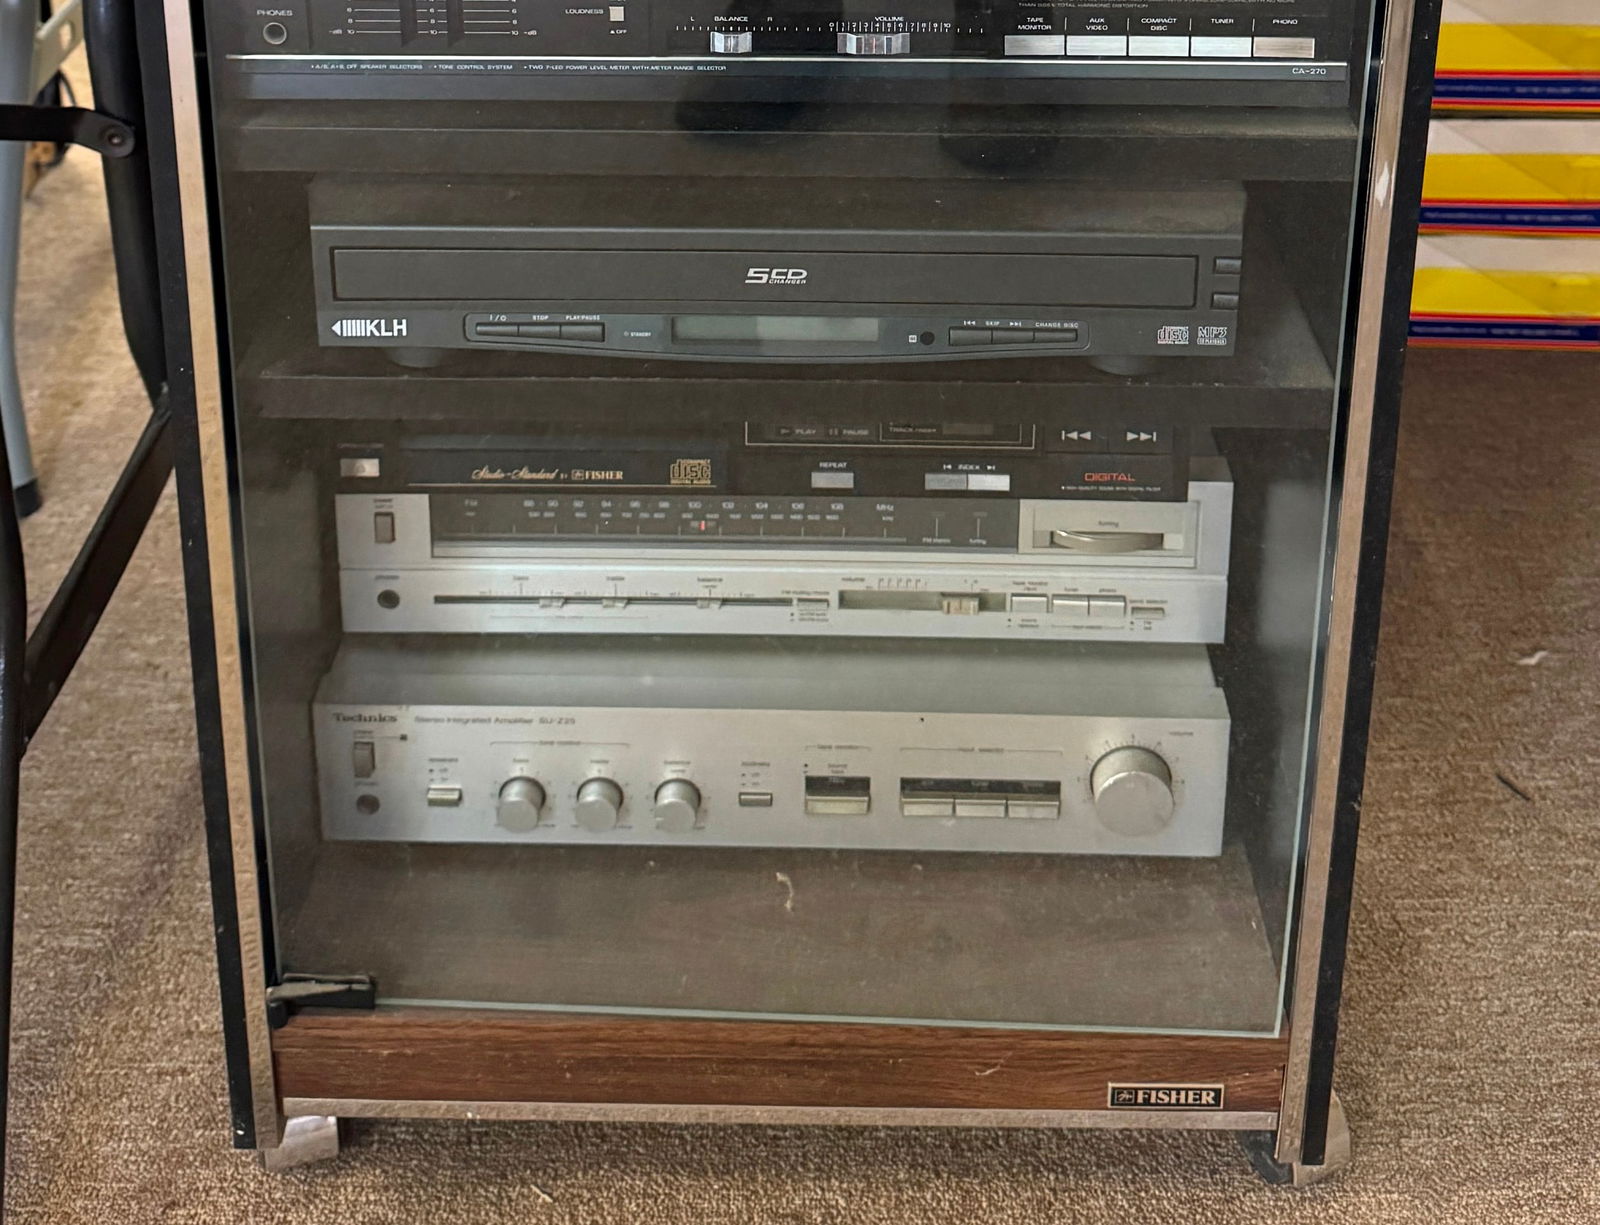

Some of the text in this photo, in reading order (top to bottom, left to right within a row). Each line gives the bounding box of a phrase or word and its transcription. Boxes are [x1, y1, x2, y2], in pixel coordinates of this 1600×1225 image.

[745, 268, 807, 283] 5 CD
[369, 320, 406, 336] KLH
[1198, 326, 1227, 337] MP3
[585, 471, 623, 480] FISHER
[1084, 473, 1135, 482] DIGITAL
[333, 713, 397, 723] Technics
[1137, 1090, 1216, 1104] FISHER
